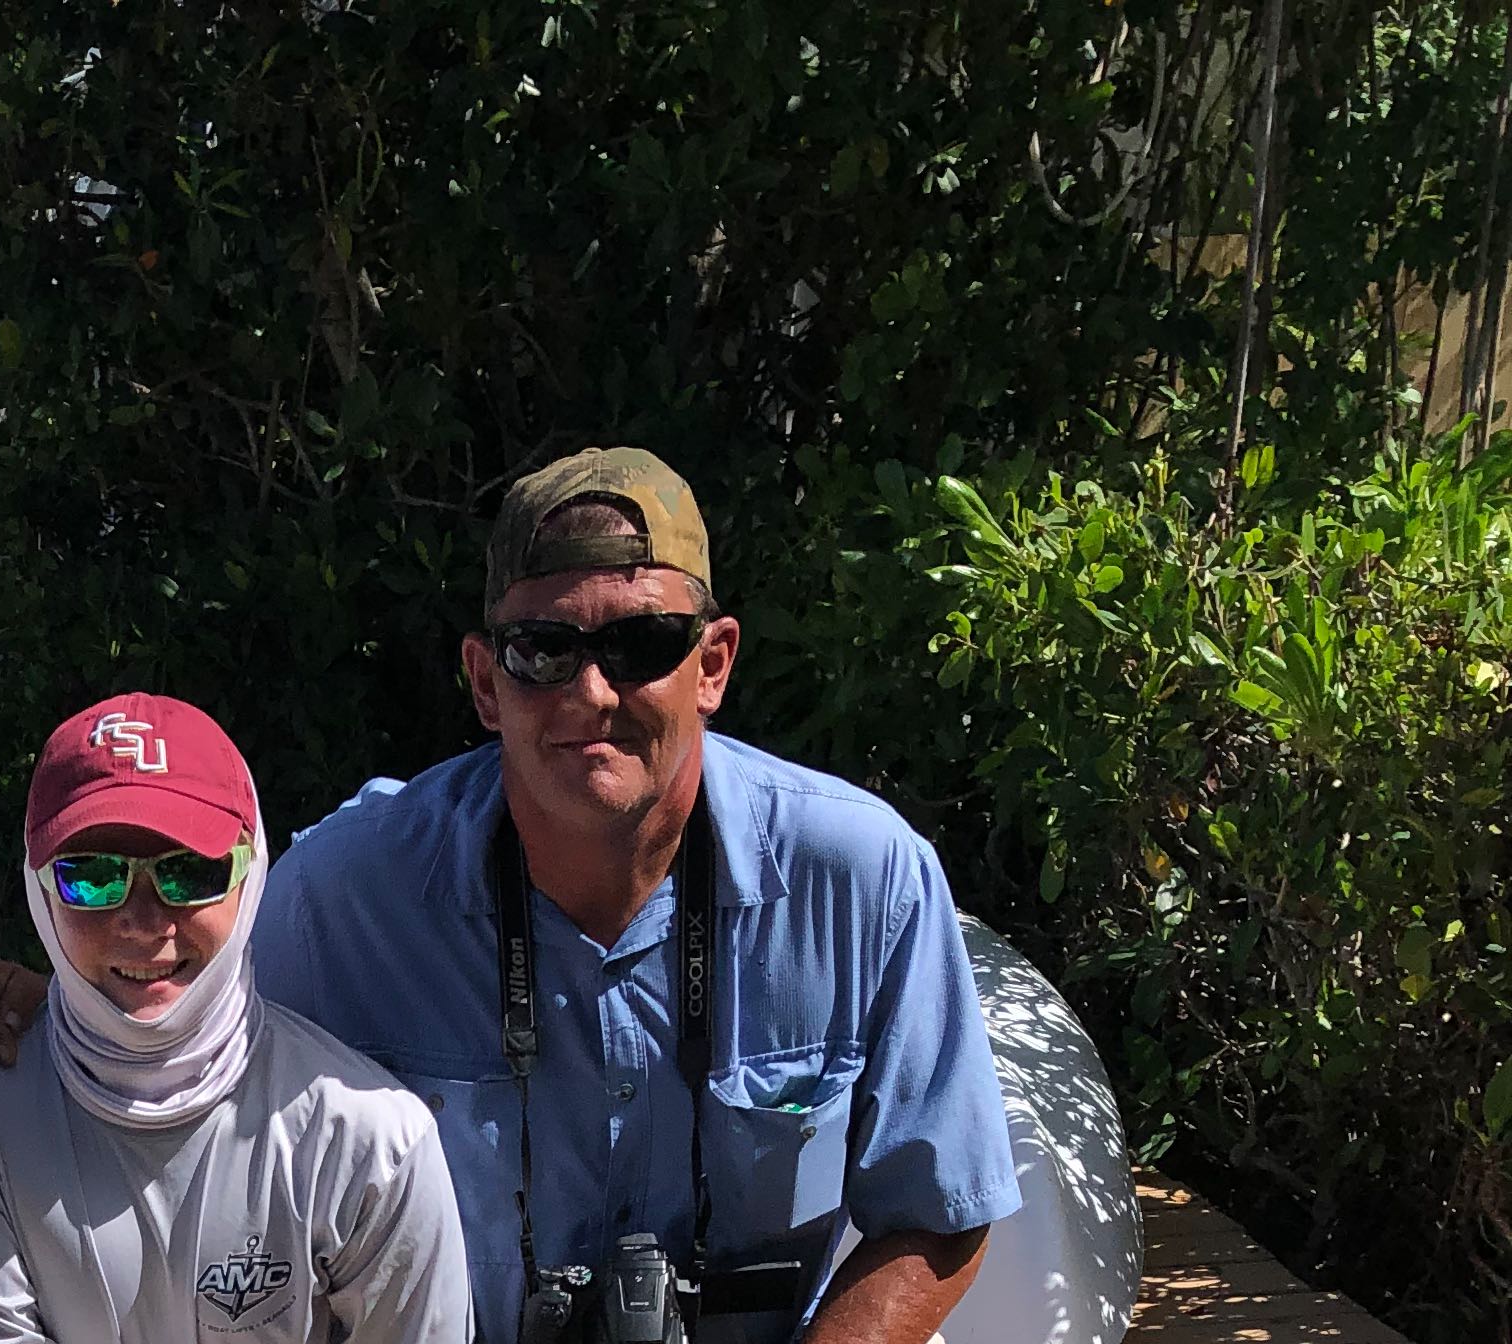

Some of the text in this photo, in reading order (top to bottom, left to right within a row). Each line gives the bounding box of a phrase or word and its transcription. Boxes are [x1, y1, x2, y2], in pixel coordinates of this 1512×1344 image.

[88, 712, 168, 773] FSU
[508, 937, 528, 1003] Nikon
[688, 912, 706, 1017] COOLPIX
[196, 1261, 293, 1294] AMC
